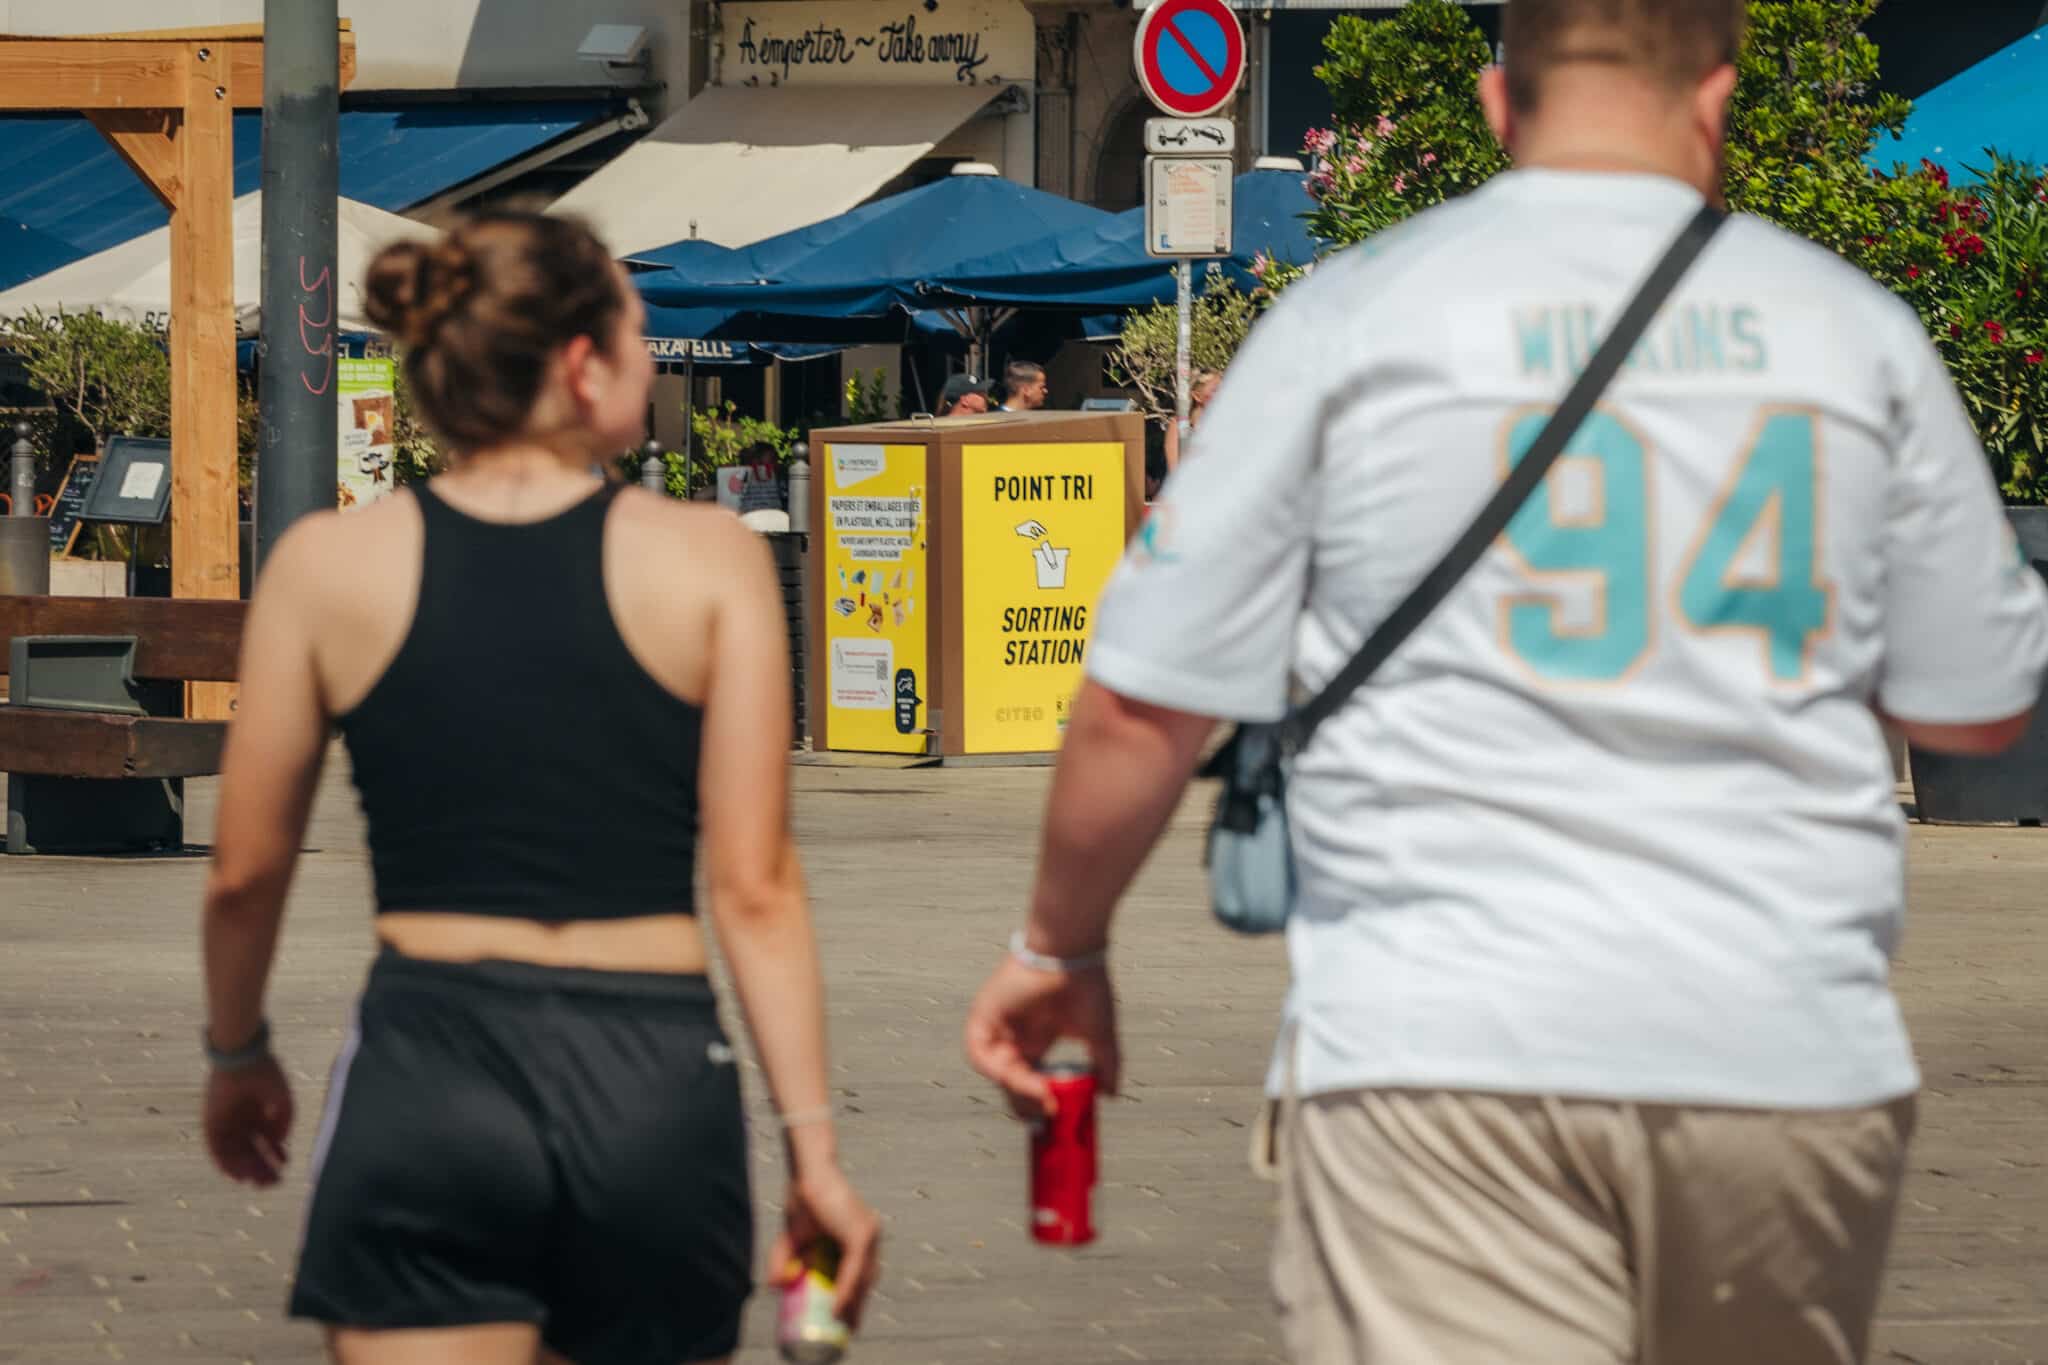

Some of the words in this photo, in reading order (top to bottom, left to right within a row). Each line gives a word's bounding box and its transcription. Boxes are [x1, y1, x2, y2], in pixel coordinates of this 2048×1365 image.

[759, 22, 854, 80] emporter
[878, 14, 924, 63] Take
[928, 32, 988, 82] away
[994, 476, 1055, 501] POINT
[1061, 475, 1092, 500] TRI
[1496, 402, 1836, 688] 94
[1002, 606, 1087, 632] SORTING
[1004, 639, 1085, 665] STATION
